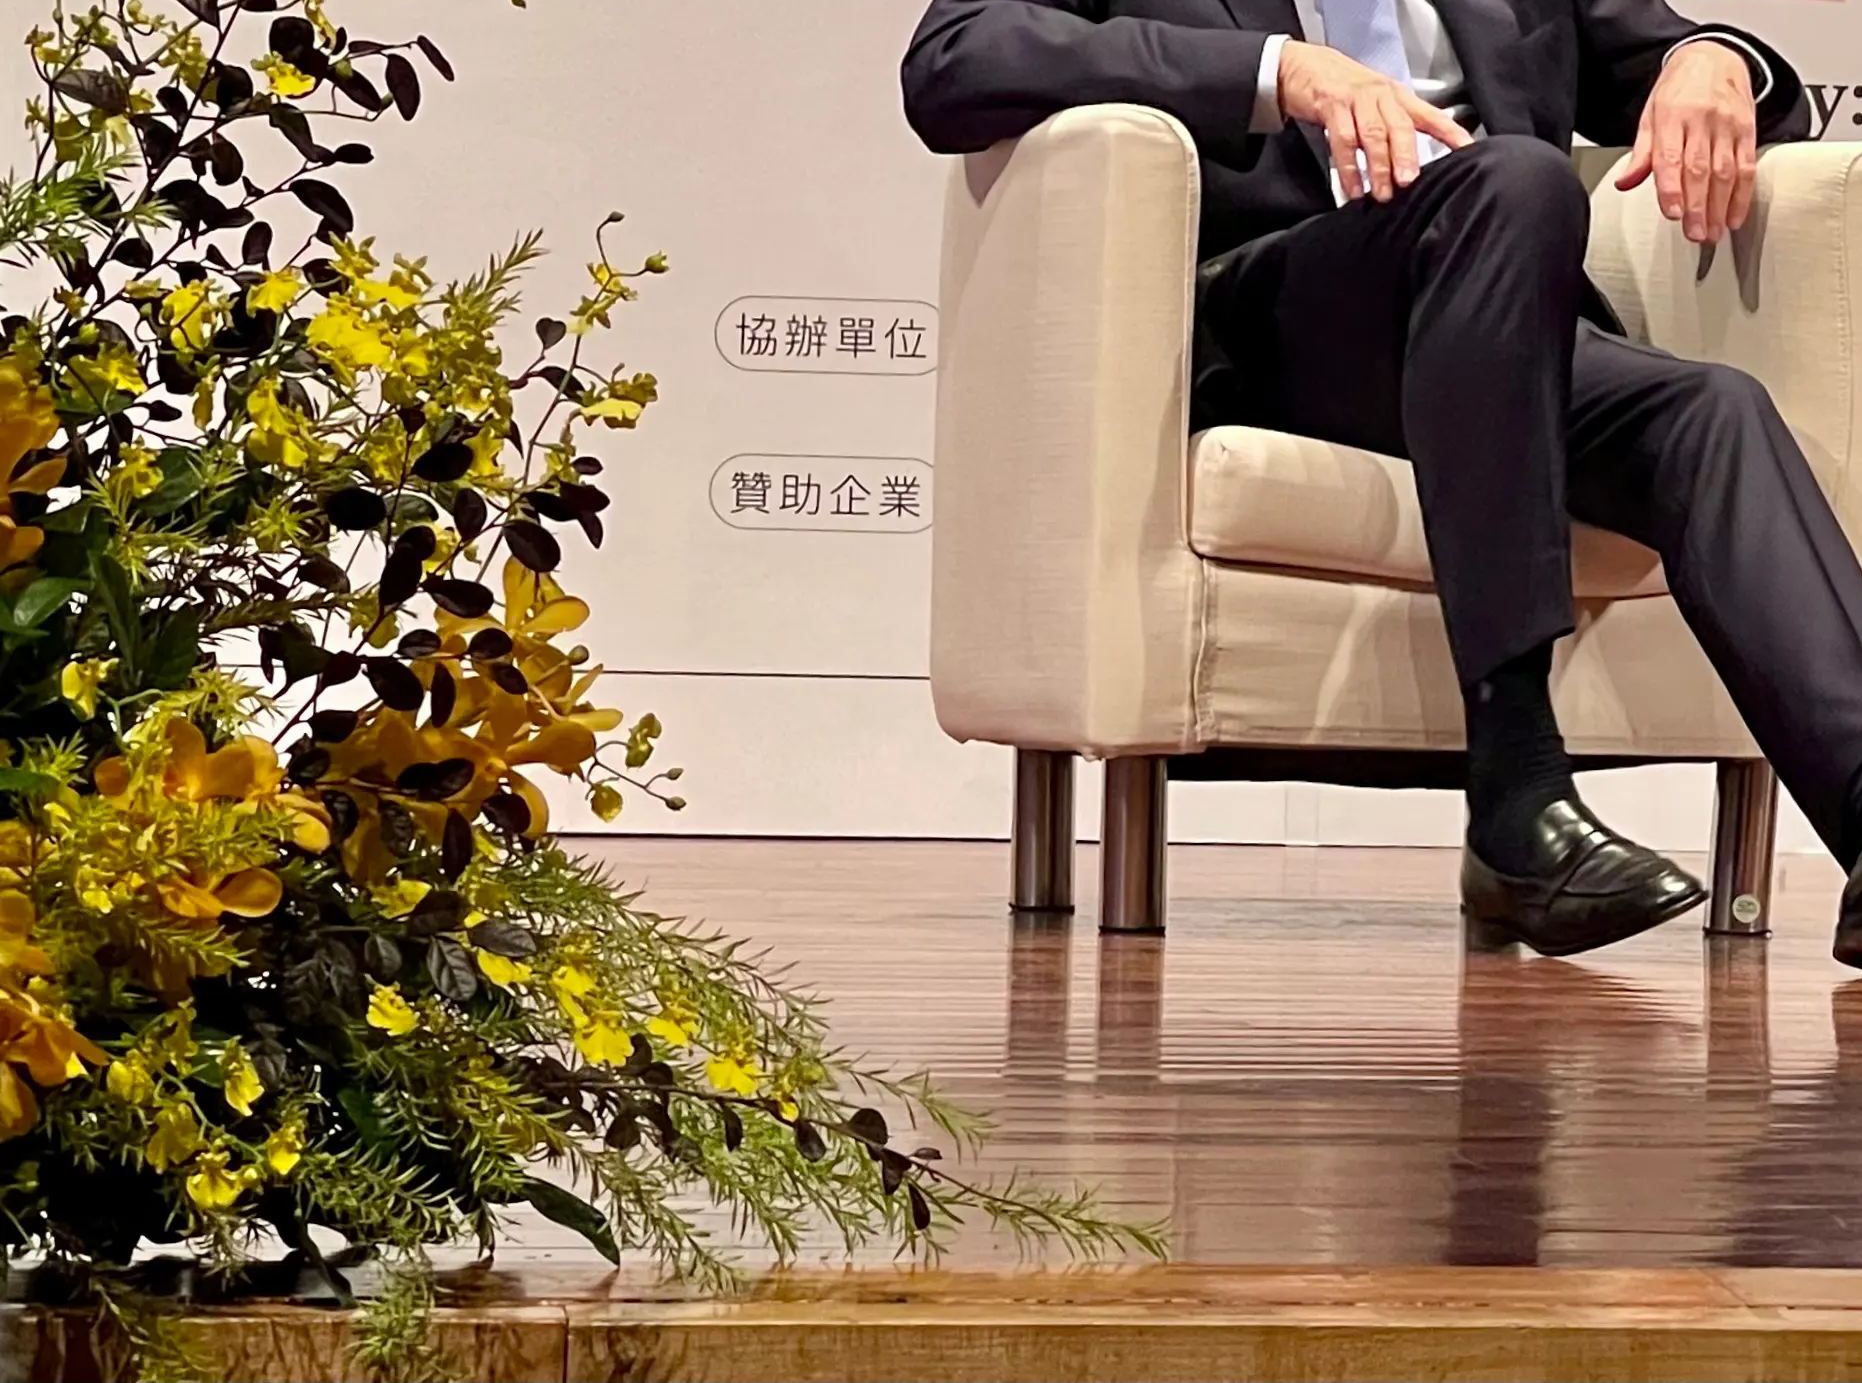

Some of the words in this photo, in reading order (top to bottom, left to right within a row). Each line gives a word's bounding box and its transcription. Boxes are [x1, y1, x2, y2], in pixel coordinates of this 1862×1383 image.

[736, 312, 927, 359] 協辦單位
[730, 471, 920, 518] 贊助企業
